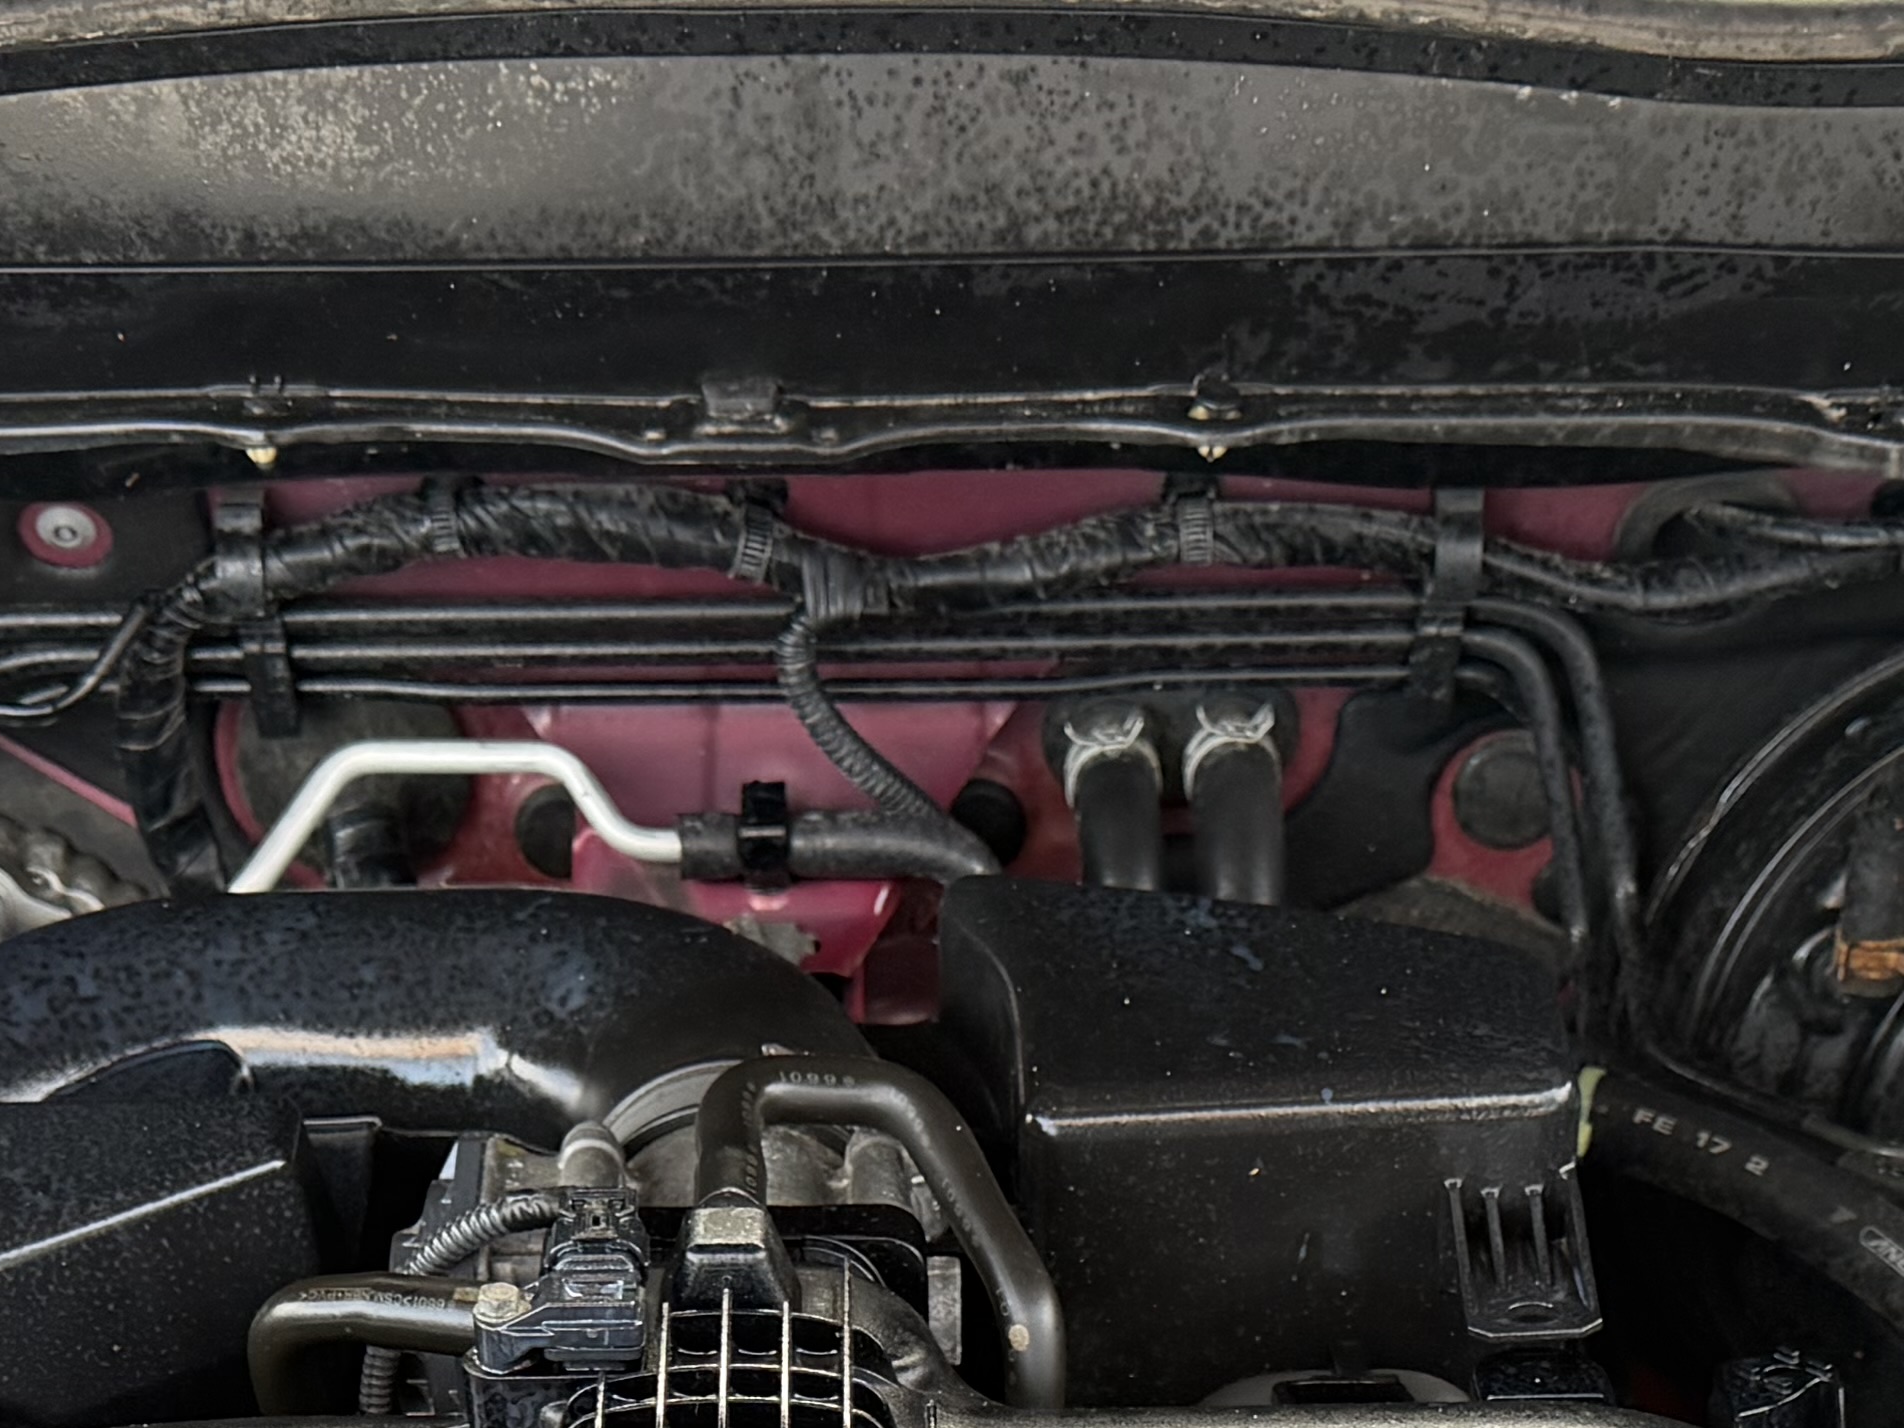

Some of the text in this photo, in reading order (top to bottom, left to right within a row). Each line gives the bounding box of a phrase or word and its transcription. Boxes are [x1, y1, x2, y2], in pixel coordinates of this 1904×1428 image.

[1633, 1108, 1769, 1176] FE 17 2
